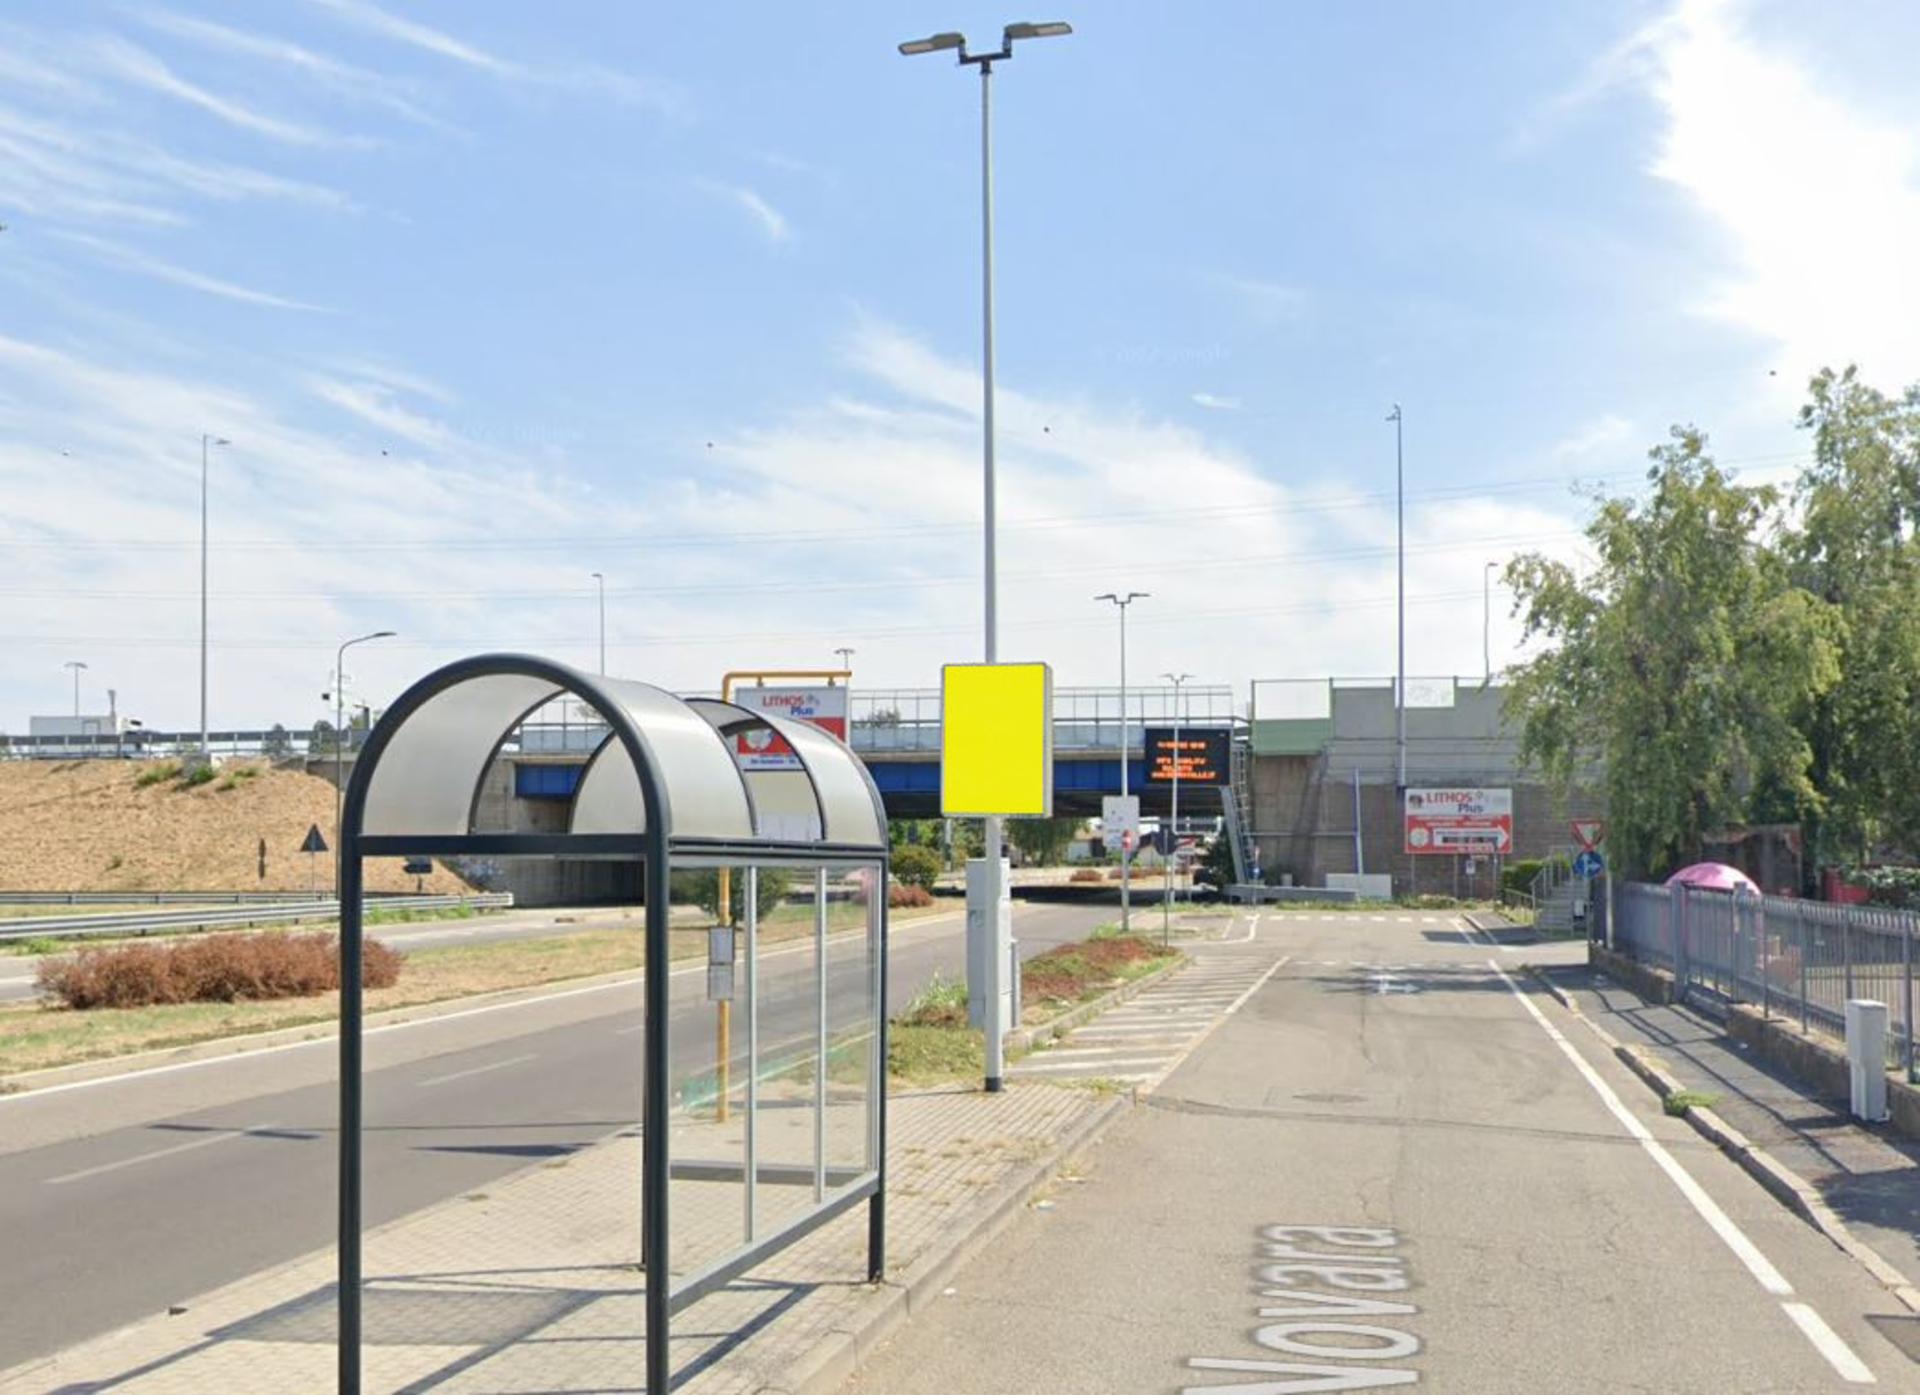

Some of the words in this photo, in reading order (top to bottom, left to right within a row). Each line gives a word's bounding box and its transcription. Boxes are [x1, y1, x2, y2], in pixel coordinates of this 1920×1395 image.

[763, 695, 804, 706] LITHOS
[791, 706, 813, 715] Plus
[1426, 792, 1472, 803] LITHOS
[1458, 803, 1483, 813] Plus
